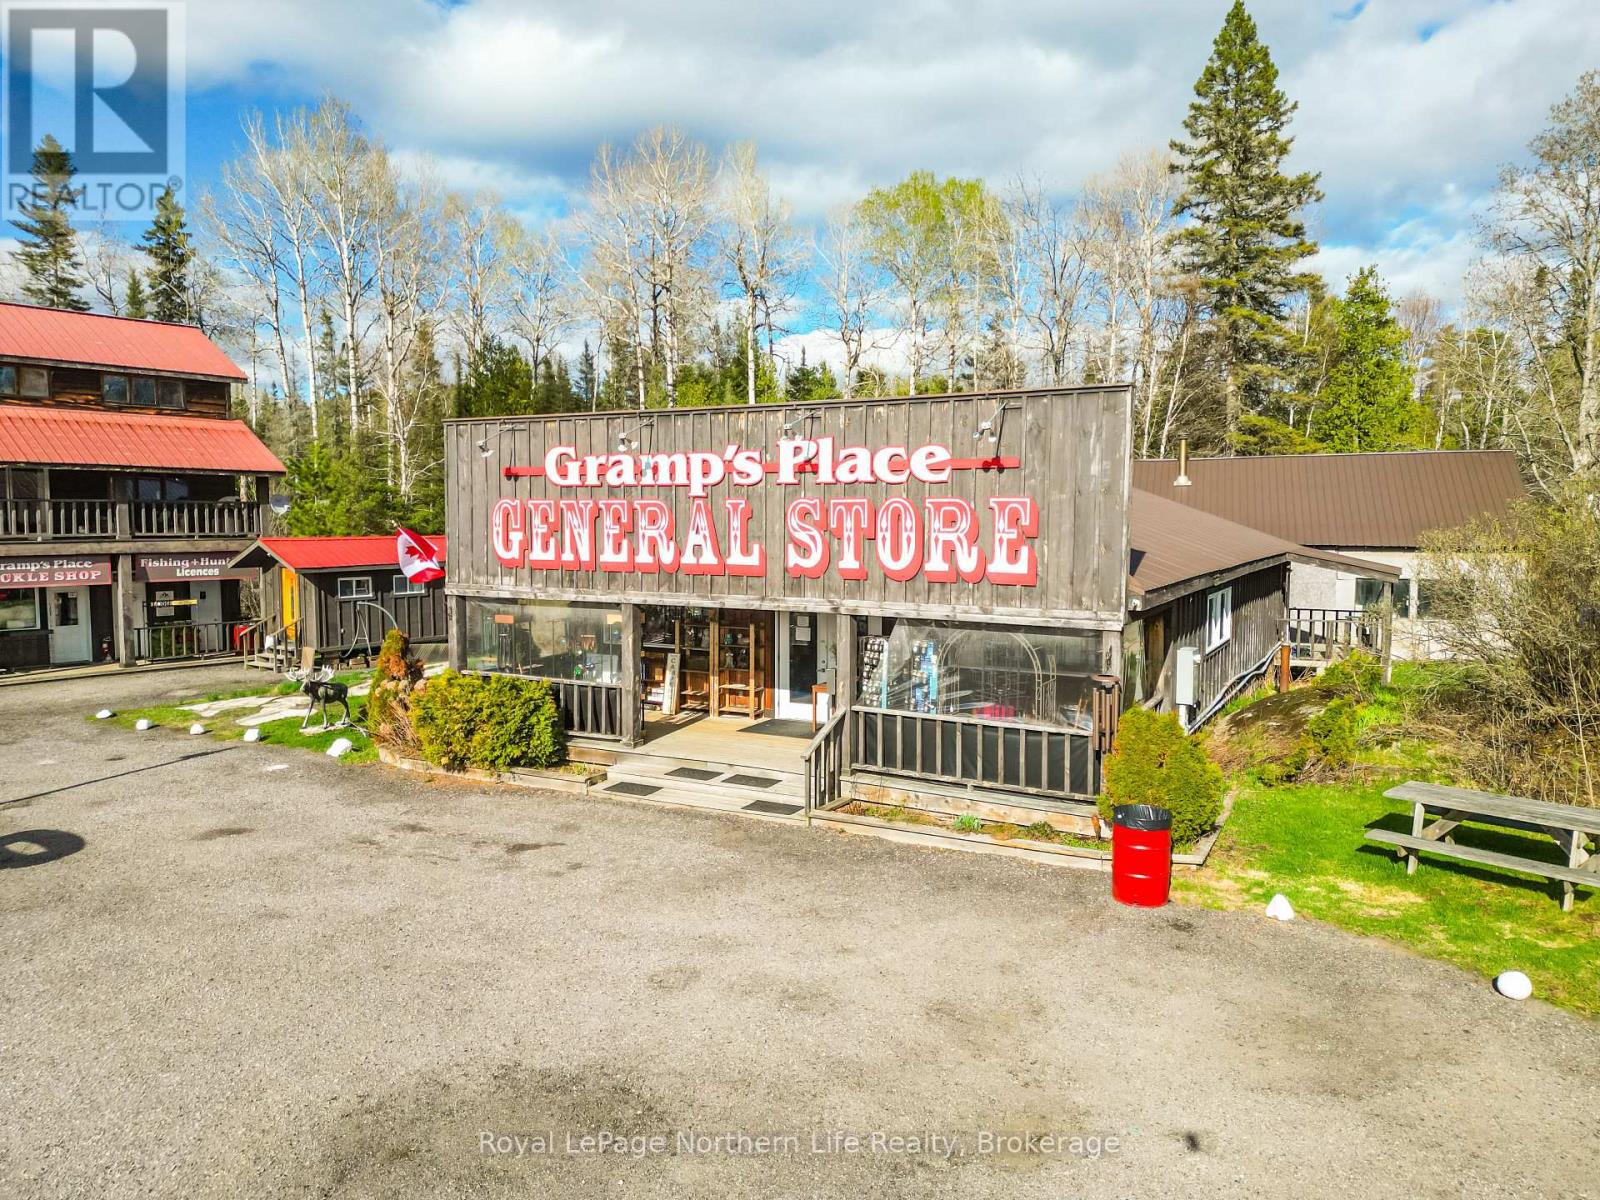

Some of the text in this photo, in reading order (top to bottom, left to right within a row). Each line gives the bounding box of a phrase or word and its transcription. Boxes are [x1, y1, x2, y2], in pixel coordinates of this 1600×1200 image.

[544, 436, 952, 498] Gramp's Place
[491, 496, 1038, 585] GENERAL STORE
[0, 559, 93, 572] ramp's Place
[0, 570, 102, 583] CKLE SHOP
[176, 568, 219, 577] Licences
